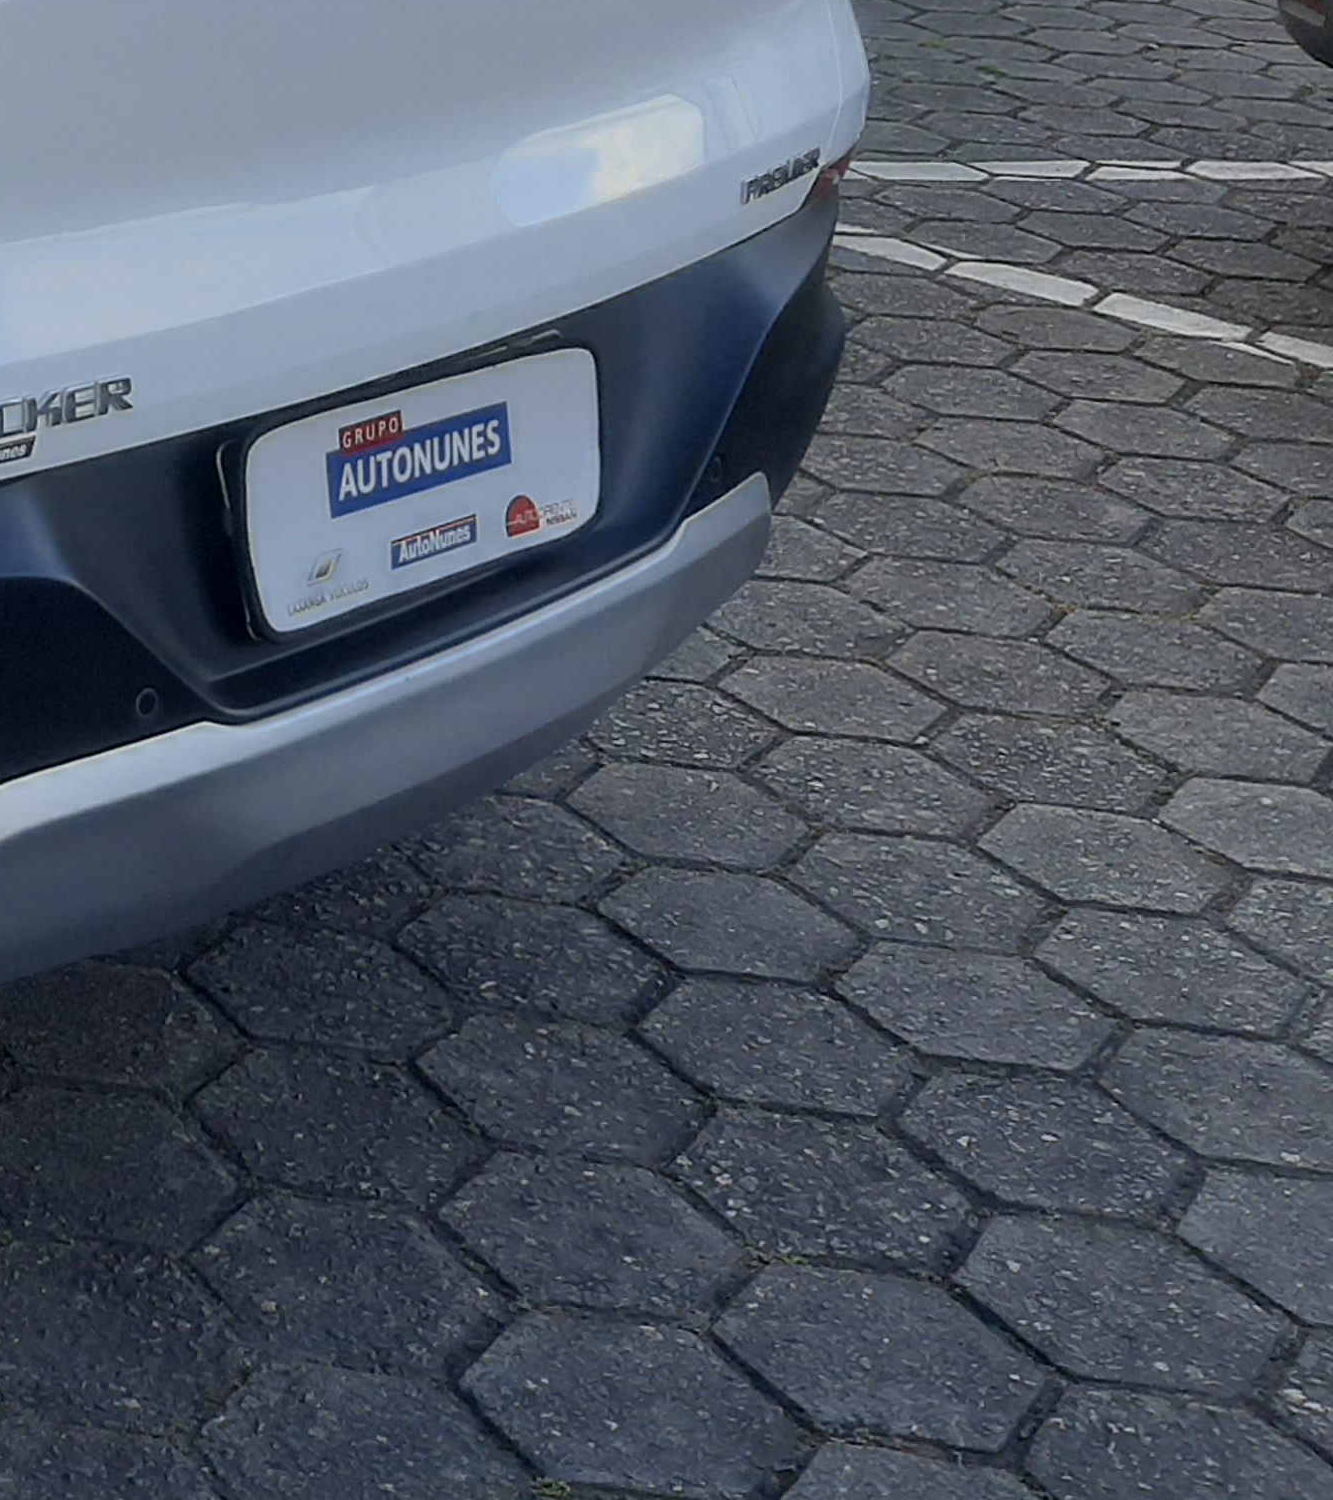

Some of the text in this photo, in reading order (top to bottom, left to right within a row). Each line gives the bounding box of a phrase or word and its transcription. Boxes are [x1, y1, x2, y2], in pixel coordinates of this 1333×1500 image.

[342, 416, 400, 449] GRUPO
[338, 419, 501, 502] AUTONUNES
[398, 524, 472, 563] AutoNunes
